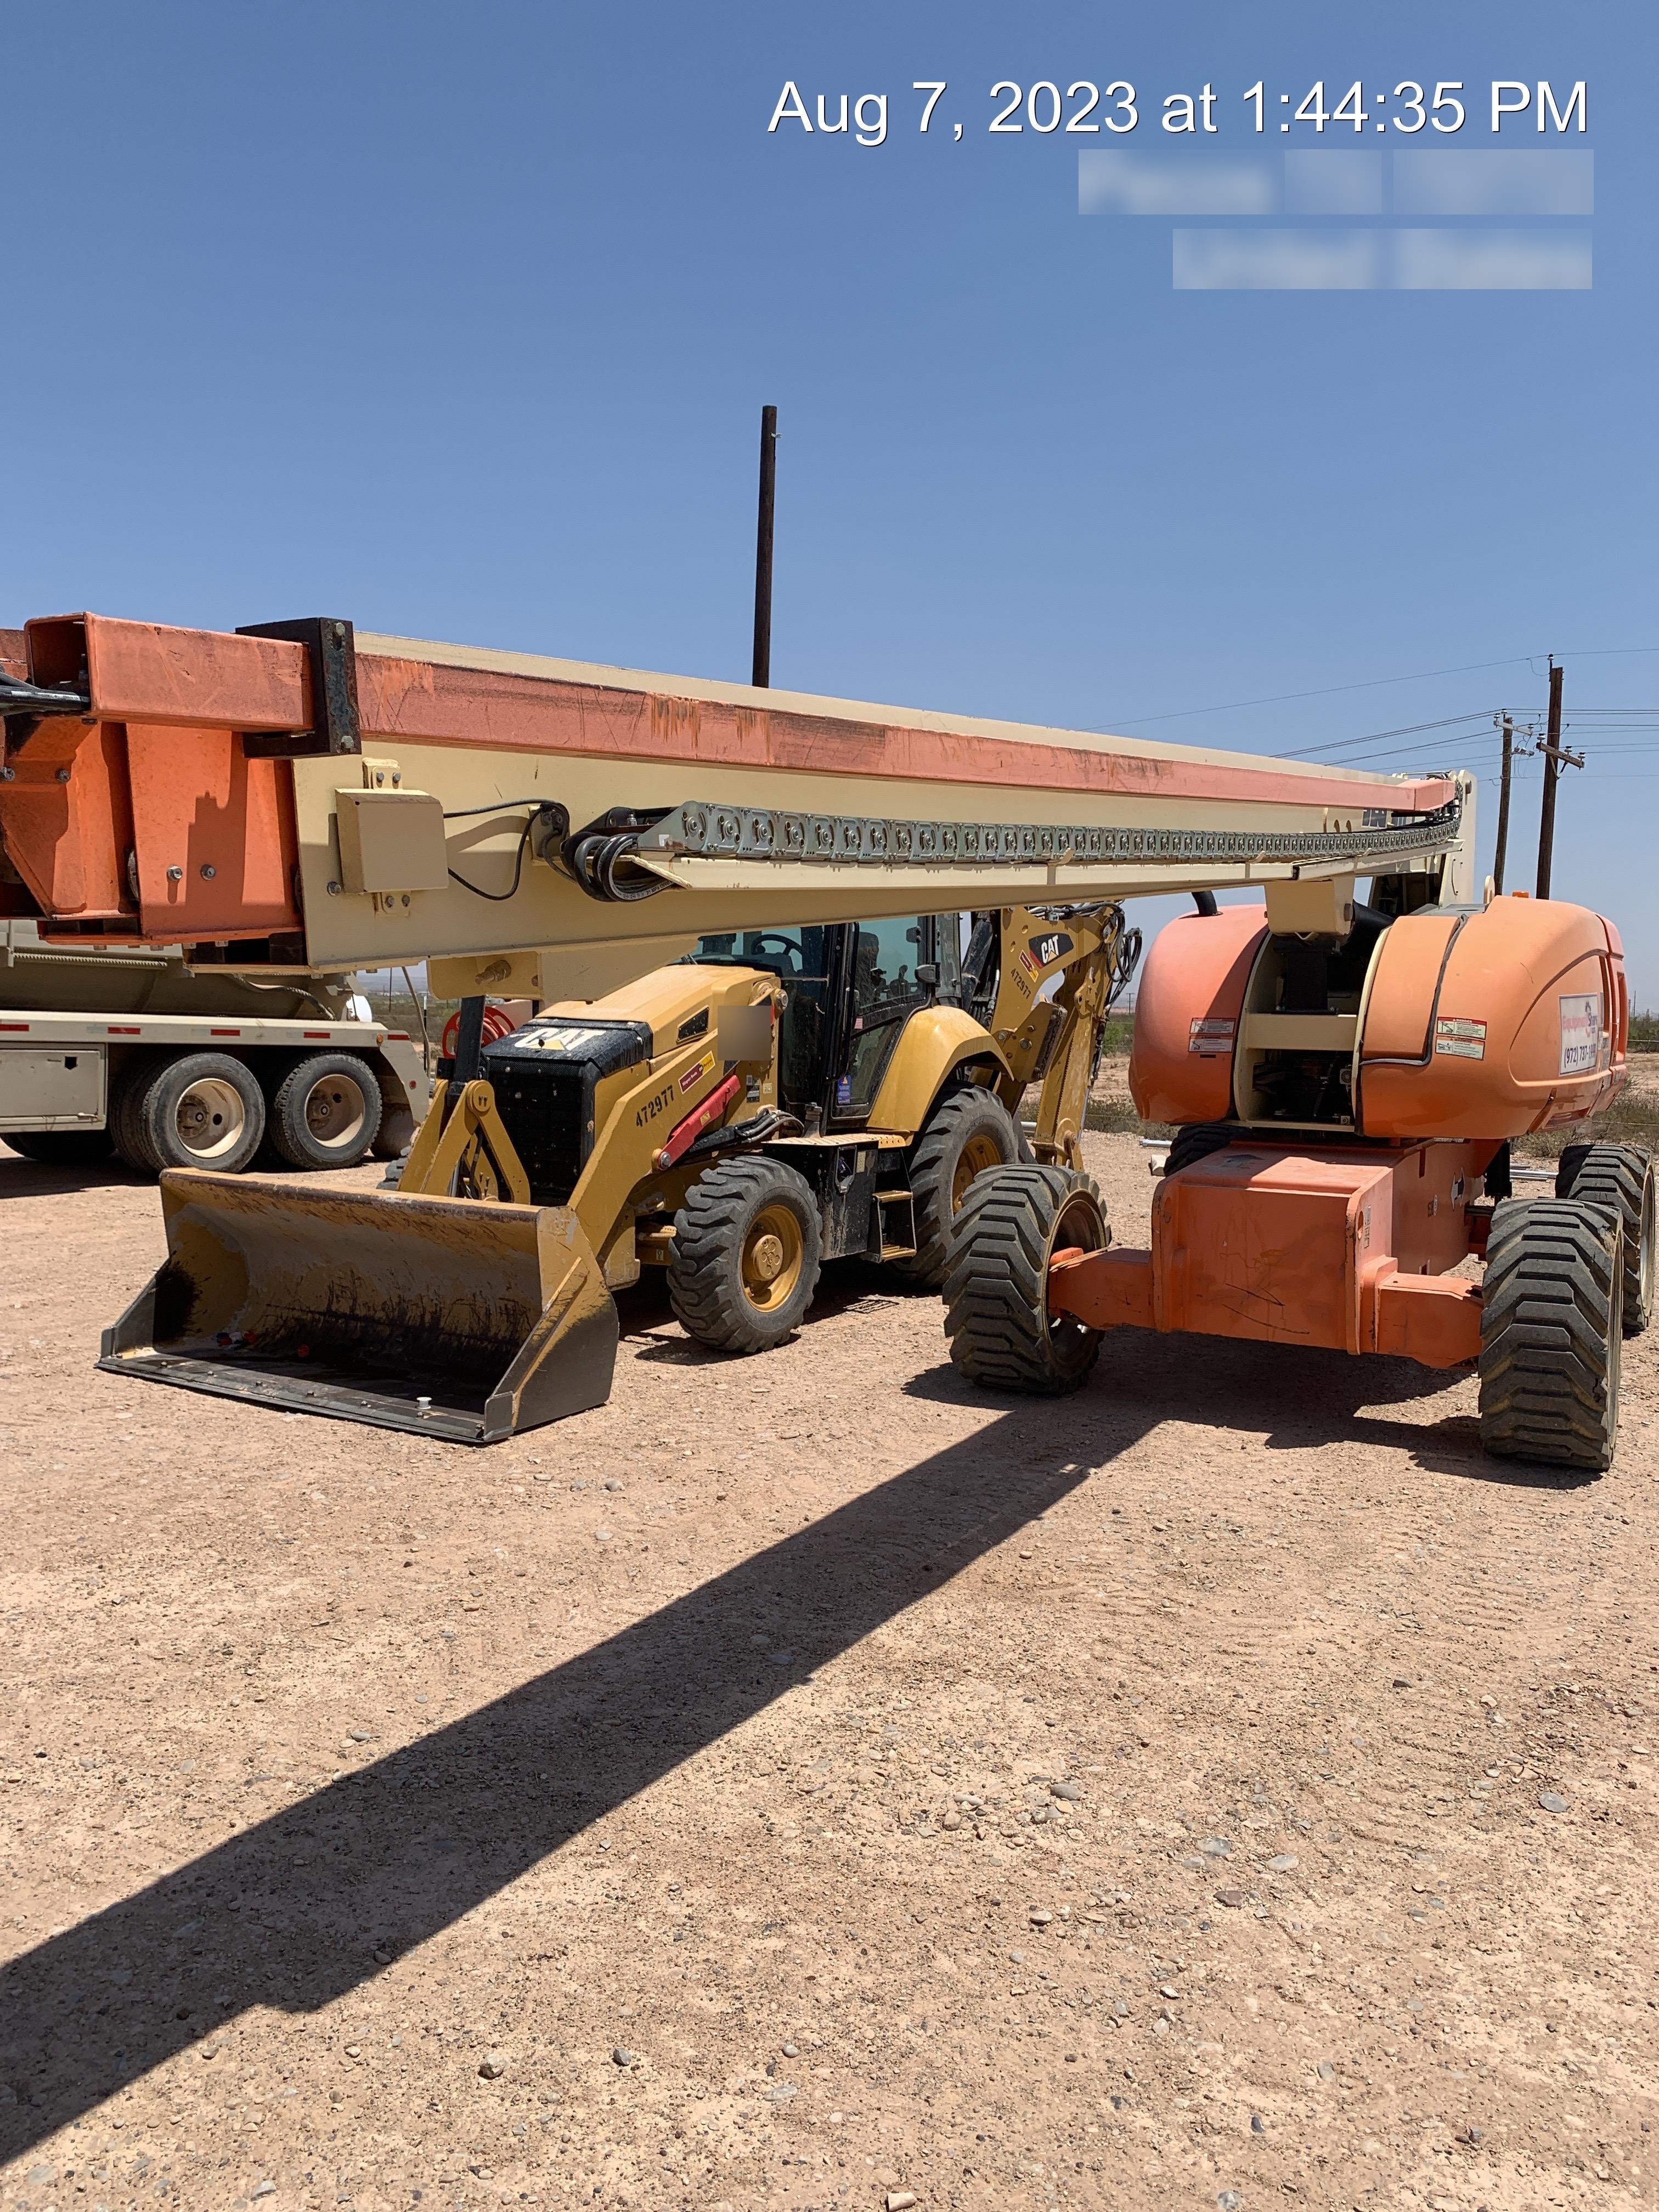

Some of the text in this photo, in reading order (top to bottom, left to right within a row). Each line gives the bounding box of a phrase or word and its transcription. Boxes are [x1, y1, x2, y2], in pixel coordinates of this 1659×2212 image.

[1041, 935, 1059, 964] CAT
[1011, 968, 1031, 1000] 472977
[514, 1027, 607, 1051] CAT
[1564, 1046, 1578, 1068] (972)
[636, 1084, 674, 1127] 472977
